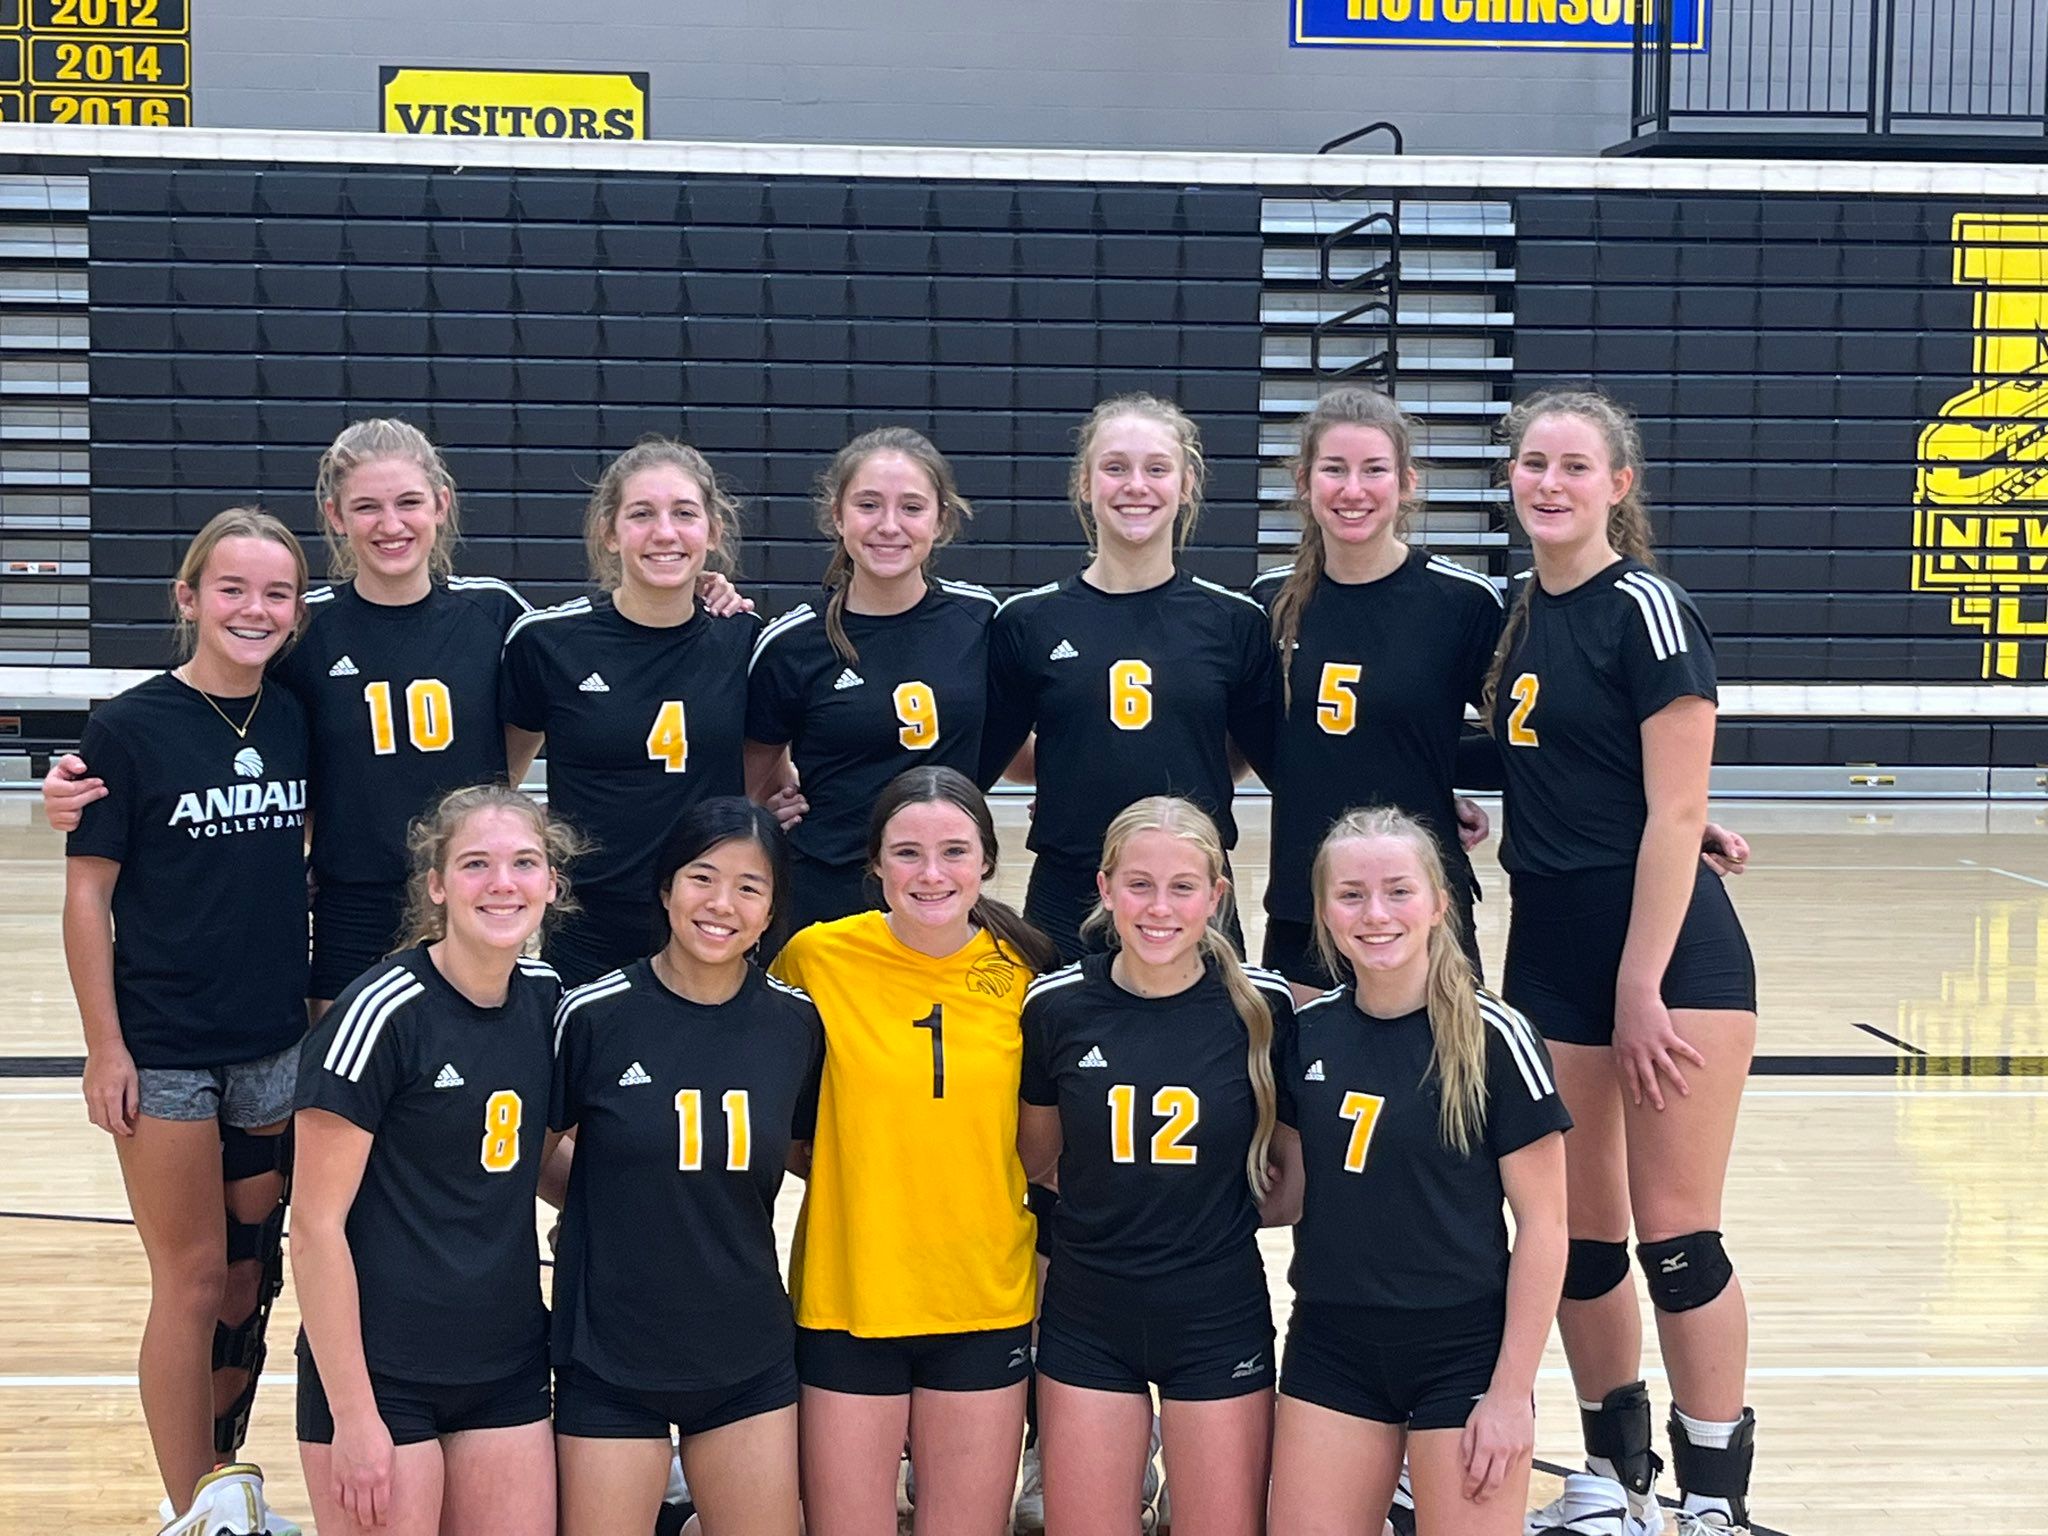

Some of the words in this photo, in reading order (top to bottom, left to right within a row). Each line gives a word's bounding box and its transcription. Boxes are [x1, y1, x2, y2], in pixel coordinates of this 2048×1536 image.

[51, 0, 158, 27] 2012
[56, 43, 162, 82] 2014
[50, 96, 170, 127] 2016
[394, 104, 635, 140] VISITORS
[364, 679, 454, 755] 10
[893, 681, 939, 750] 9
[1109, 660, 1152, 730] 6
[1317, 663, 1362, 735] 5
[1508, 673, 1539, 747] 2
[647, 701, 688, 773] 4
[913, 1004, 944, 1098] 1
[481, 1090, 522, 1172] 8
[674, 1089, 750, 1171] 11
[1108, 1085, 1200, 1164] 12
[1339, 1091, 1386, 1173] 7
